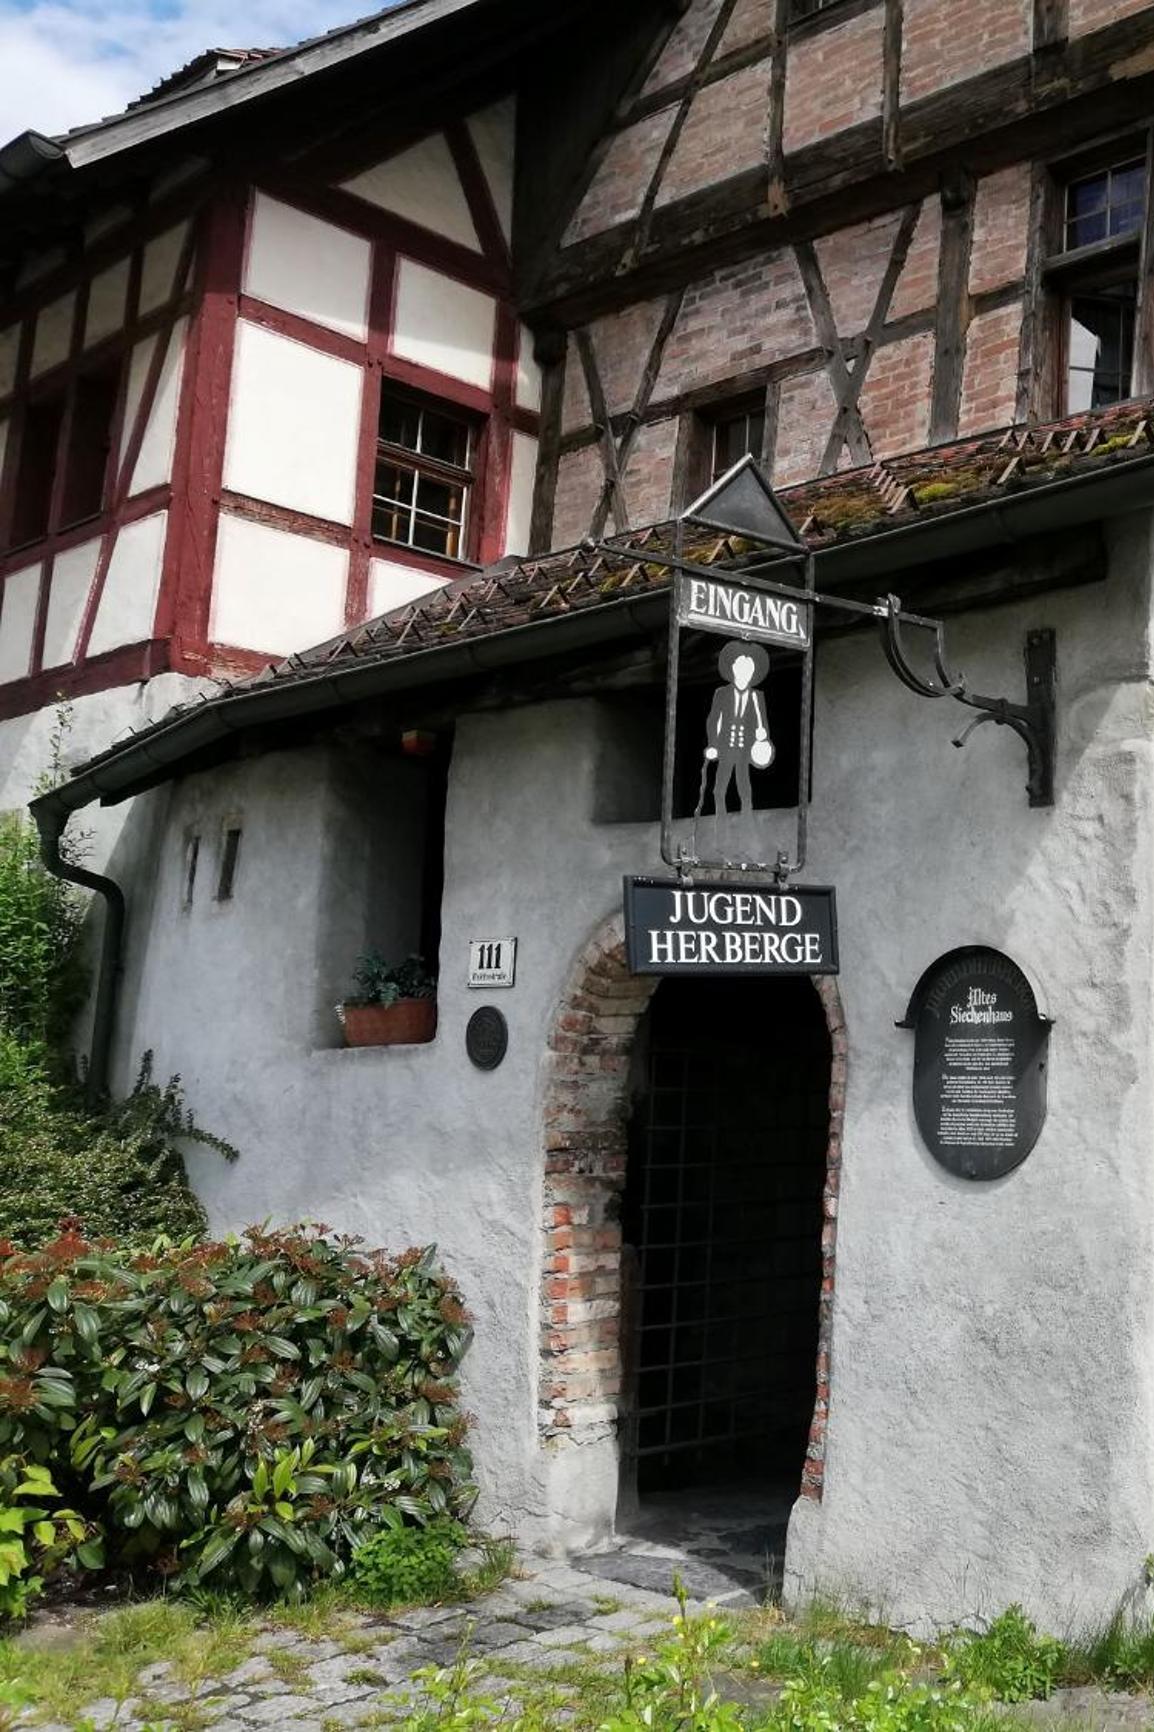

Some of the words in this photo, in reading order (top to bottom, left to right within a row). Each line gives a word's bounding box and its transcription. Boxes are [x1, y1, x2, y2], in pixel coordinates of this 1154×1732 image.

[690, 579, 798, 634] EINGANG
[669, 890, 803, 927] JUGEND
[478, 943, 502, 969] 111
[648, 929, 823, 964] HERBERGE
[966, 986, 998, 1008] Altes
[949, 1003, 1013, 1025] Siechenhaus
